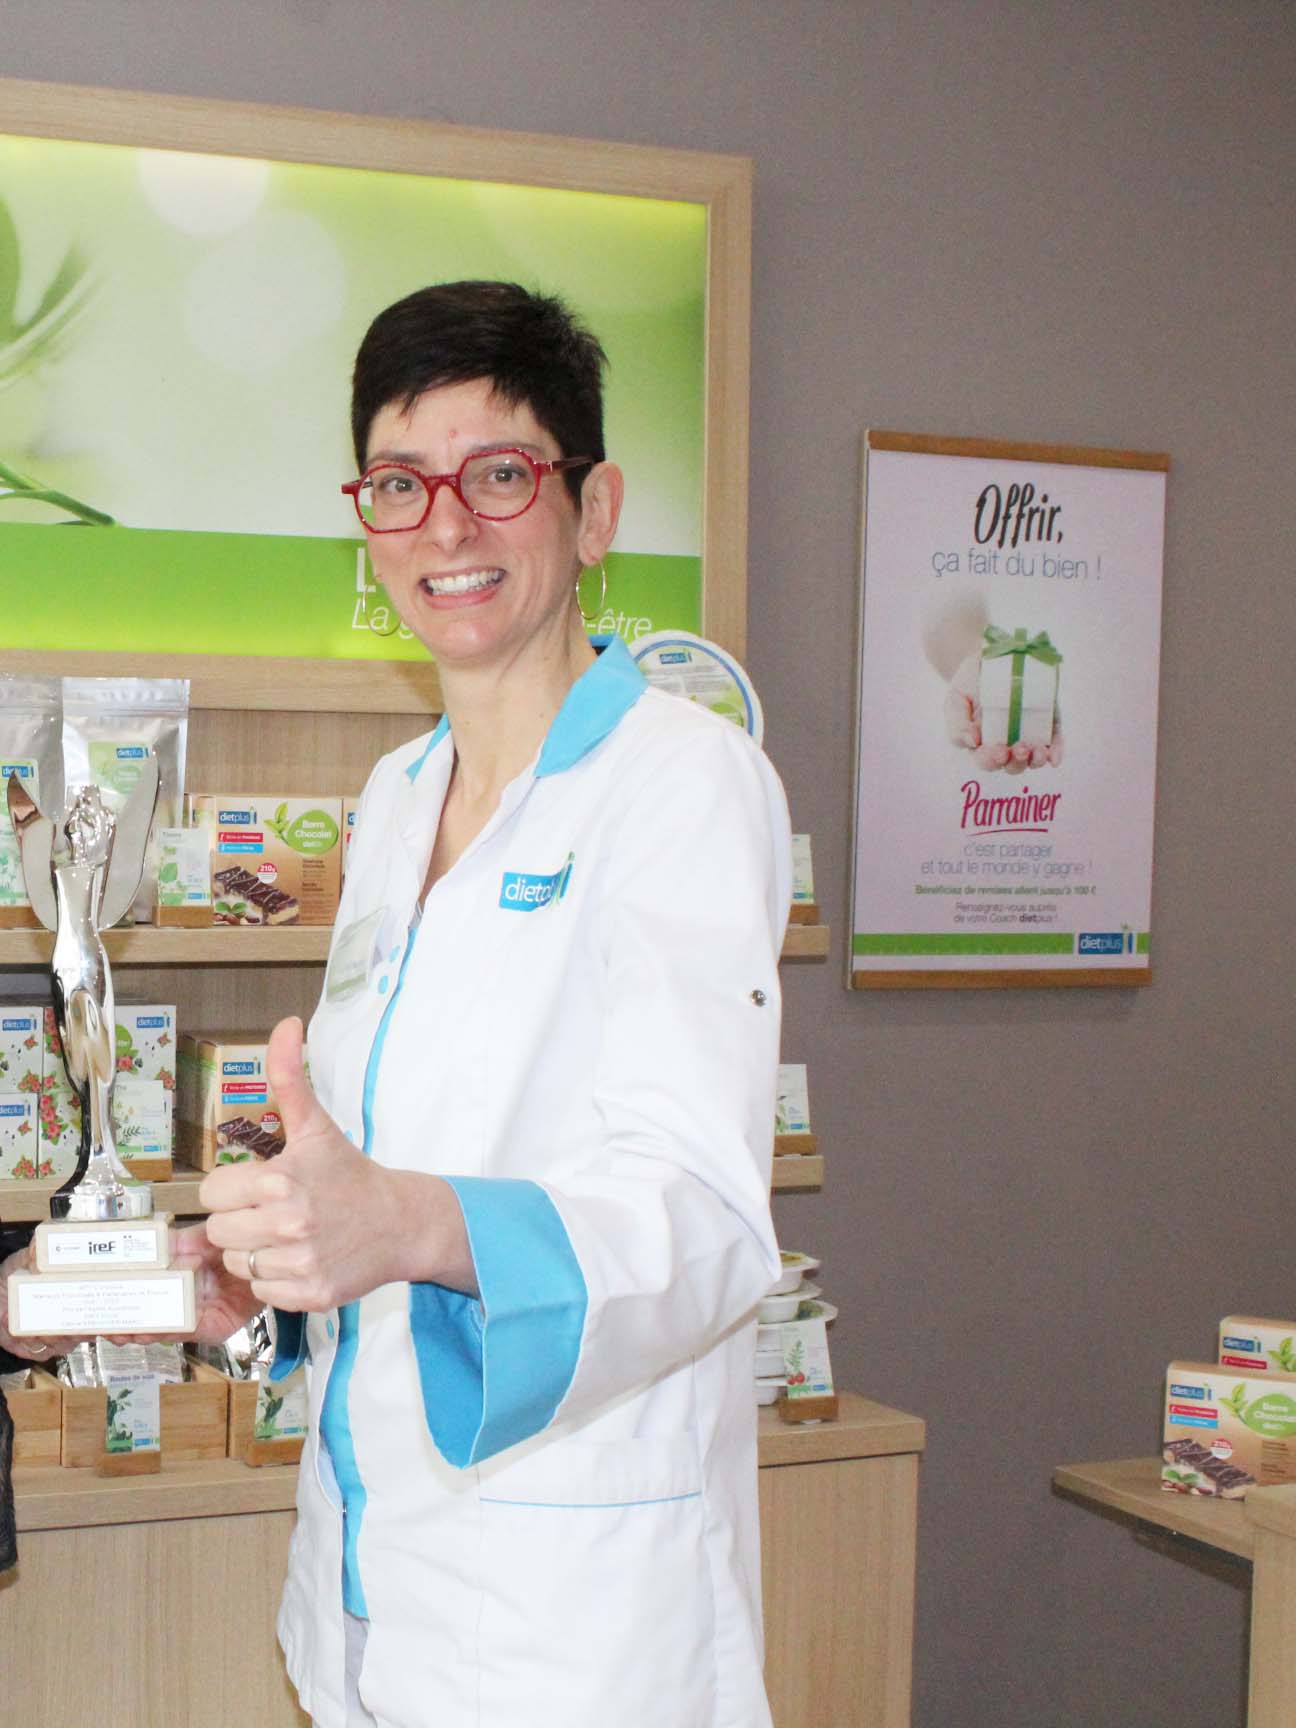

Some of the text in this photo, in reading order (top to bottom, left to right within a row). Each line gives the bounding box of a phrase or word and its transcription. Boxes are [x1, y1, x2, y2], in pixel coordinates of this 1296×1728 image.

[974, 482, 1063, 549] Offrir,
[356, 547, 376, 593] L
[931, 551, 961, 578] ça
[968, 547, 1000, 575] fait
[1006, 551, 1035, 577] du
[1042, 552, 1089, 580] bien
[352, 598, 389, 630] La
[581, 608, 652, 639] -être
[219, 812, 251, 824] dietplus
[960, 780, 1062, 829] Parrainer
[963, 842, 1053, 861] c'est partager
[920, 859, 934, 874] et
[937, 859, 964, 875] tout
[981, 860, 1031, 876] monde
[1080, 934, 1122, 953] dietplus
[223, 1064, 253, 1074] dietplus
